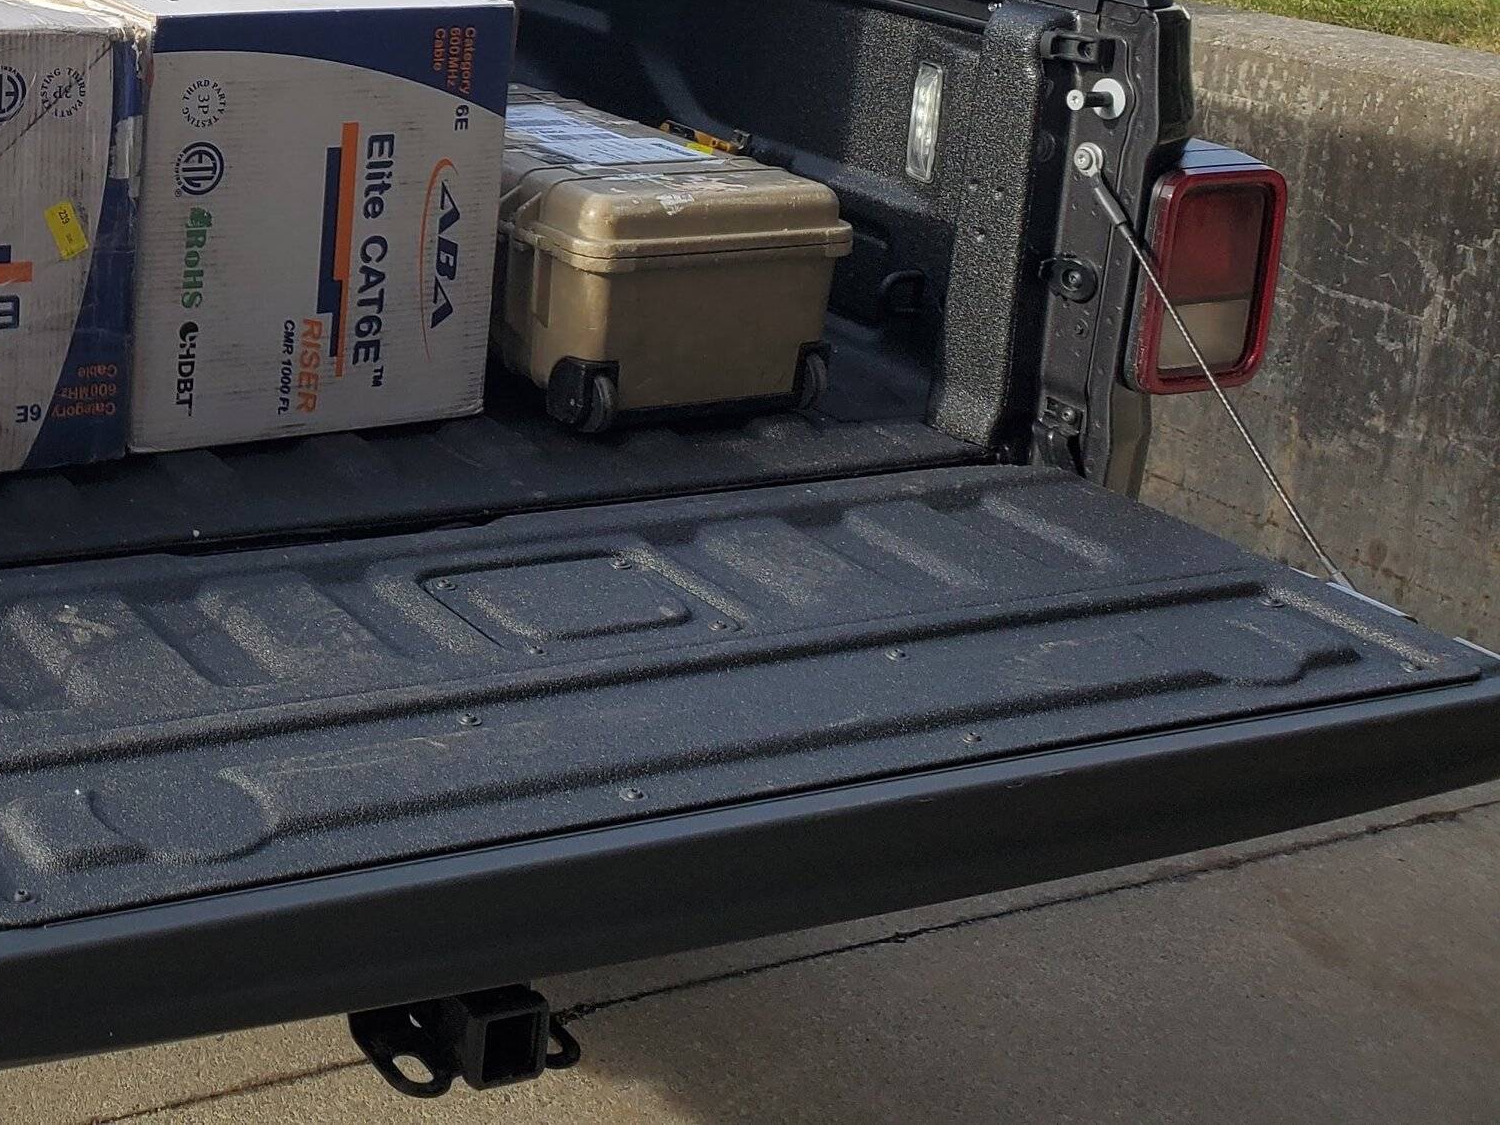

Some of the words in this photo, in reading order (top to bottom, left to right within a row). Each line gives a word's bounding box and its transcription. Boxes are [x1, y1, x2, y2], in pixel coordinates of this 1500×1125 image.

[433, 28, 446, 71] Cable
[460, 27, 476, 94] Category
[182, 79, 210, 100] THIRD
[211, 82, 226, 115] PARTY
[197, 94, 210, 115] 3P
[454, 104, 470, 131] 6E
[363, 133, 396, 220] Elite
[181, 228, 207, 309] RoHS
[430, 180, 461, 329] ABA
[280, 319, 296, 356] CMR
[77, 363, 118, 378] Cable
[279, 358, 293, 396] 1000
[296, 318, 324, 413] RISER
[15, 405, 42, 423] 6E
[51, 401, 116, 420] Category
